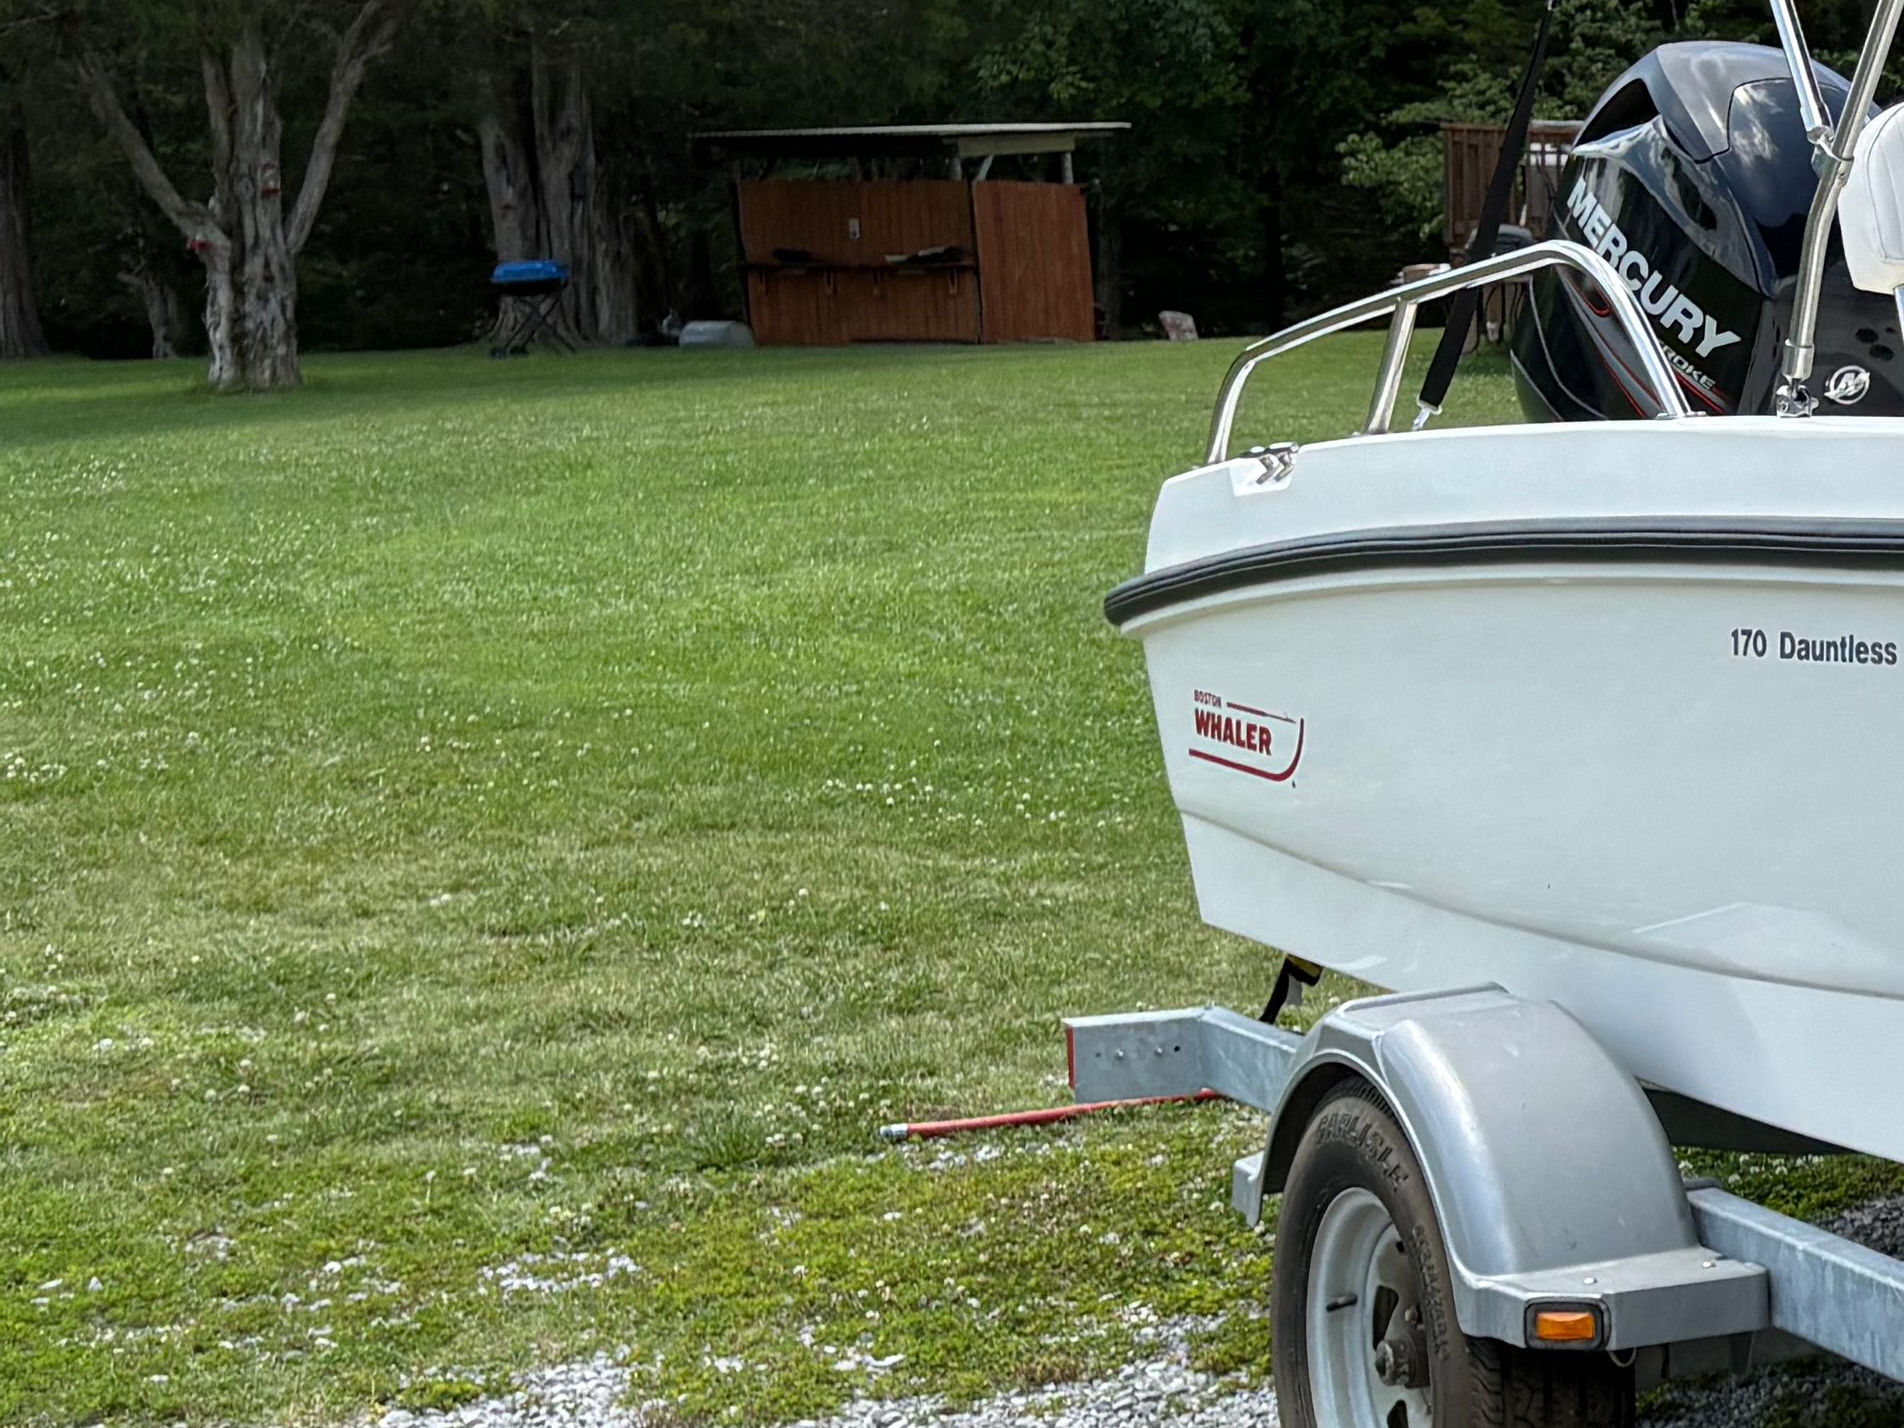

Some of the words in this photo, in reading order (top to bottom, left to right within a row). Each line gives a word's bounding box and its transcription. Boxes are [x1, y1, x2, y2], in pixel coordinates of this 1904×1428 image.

[1567, 175, 1741, 358] MERCURY
[1731, 628, 1767, 658] 170
[1780, 631, 1897, 665] Dauntless
[1194, 689, 1222, 708] BOSTON
[1195, 707, 1272, 756] WHALER
